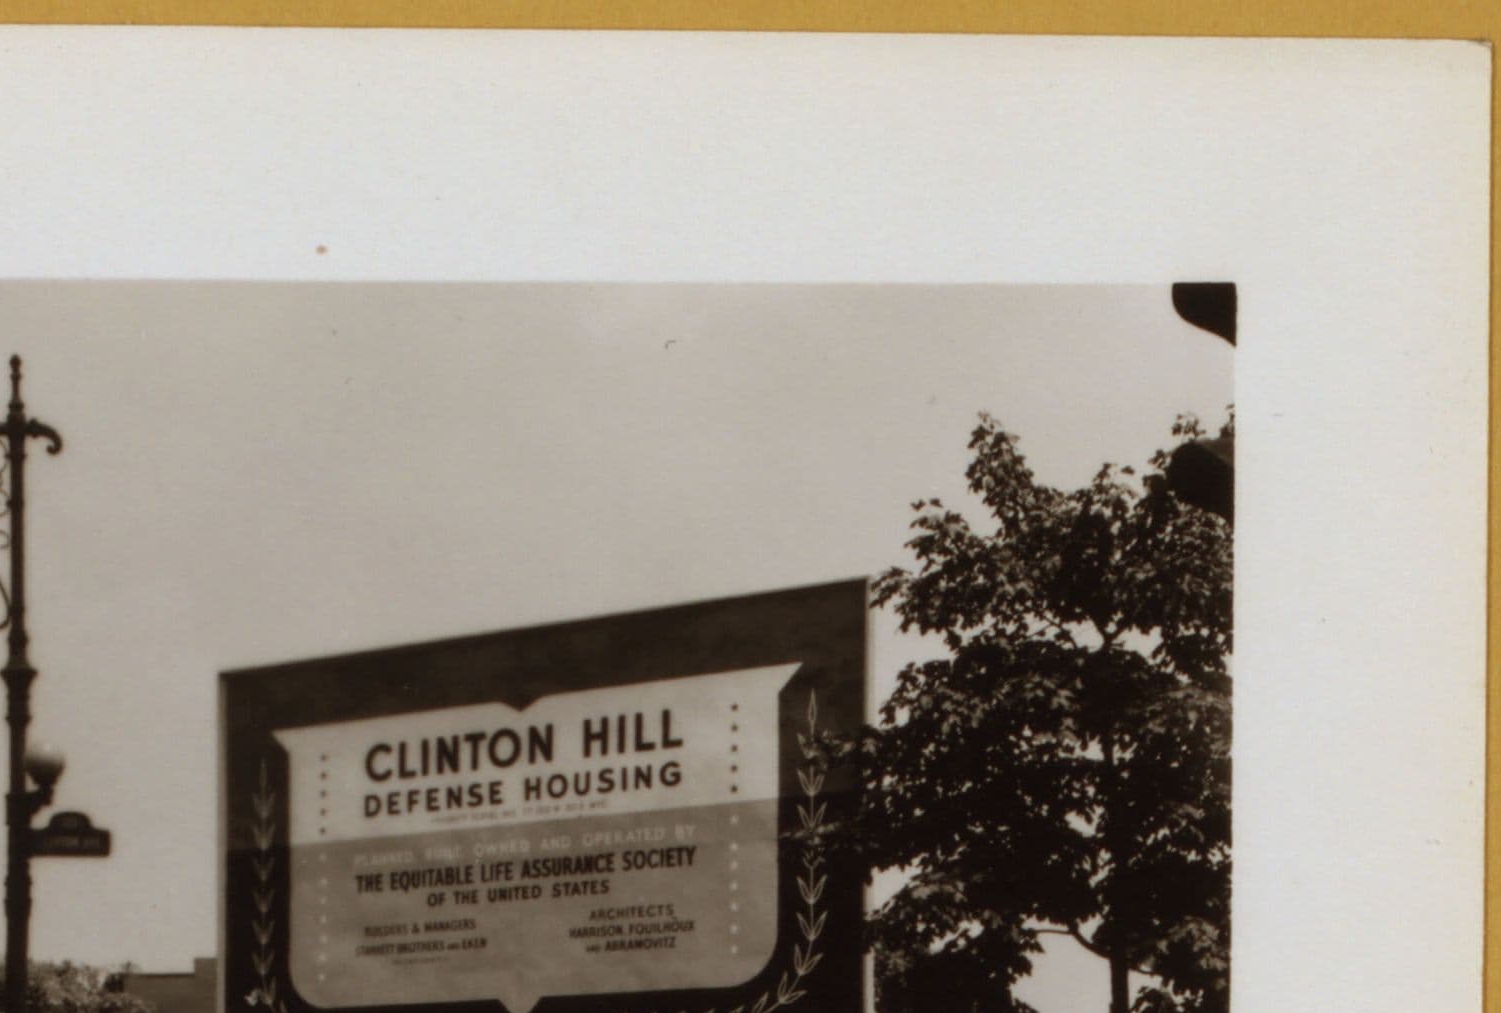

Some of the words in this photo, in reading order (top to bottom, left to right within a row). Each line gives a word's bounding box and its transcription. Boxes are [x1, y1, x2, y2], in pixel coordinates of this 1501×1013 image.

[365, 723, 554, 783] CLINTON
[582, 708, 684, 759] HILL
[363, 780, 504, 818] DEFENSE
[523, 761, 684, 802] HOUSING
[582, 826, 666, 848] OPERATED
[674, 823, 697, 840] BY
[355, 873, 383, 894] THE
[390, 865, 474, 893] EQUITABLE
[480, 861, 514, 883] LIFE
[521, 852, 615, 879] ASSURANCE
[622, 846, 697, 872] SOCIETY
[426, 893, 446, 907] OF
[454, 889, 478, 905] THE
[487, 885, 542, 902] UNITED
[552, 879, 610, 899] STATES
[589, 903, 675, 921] ARCHITECTS
